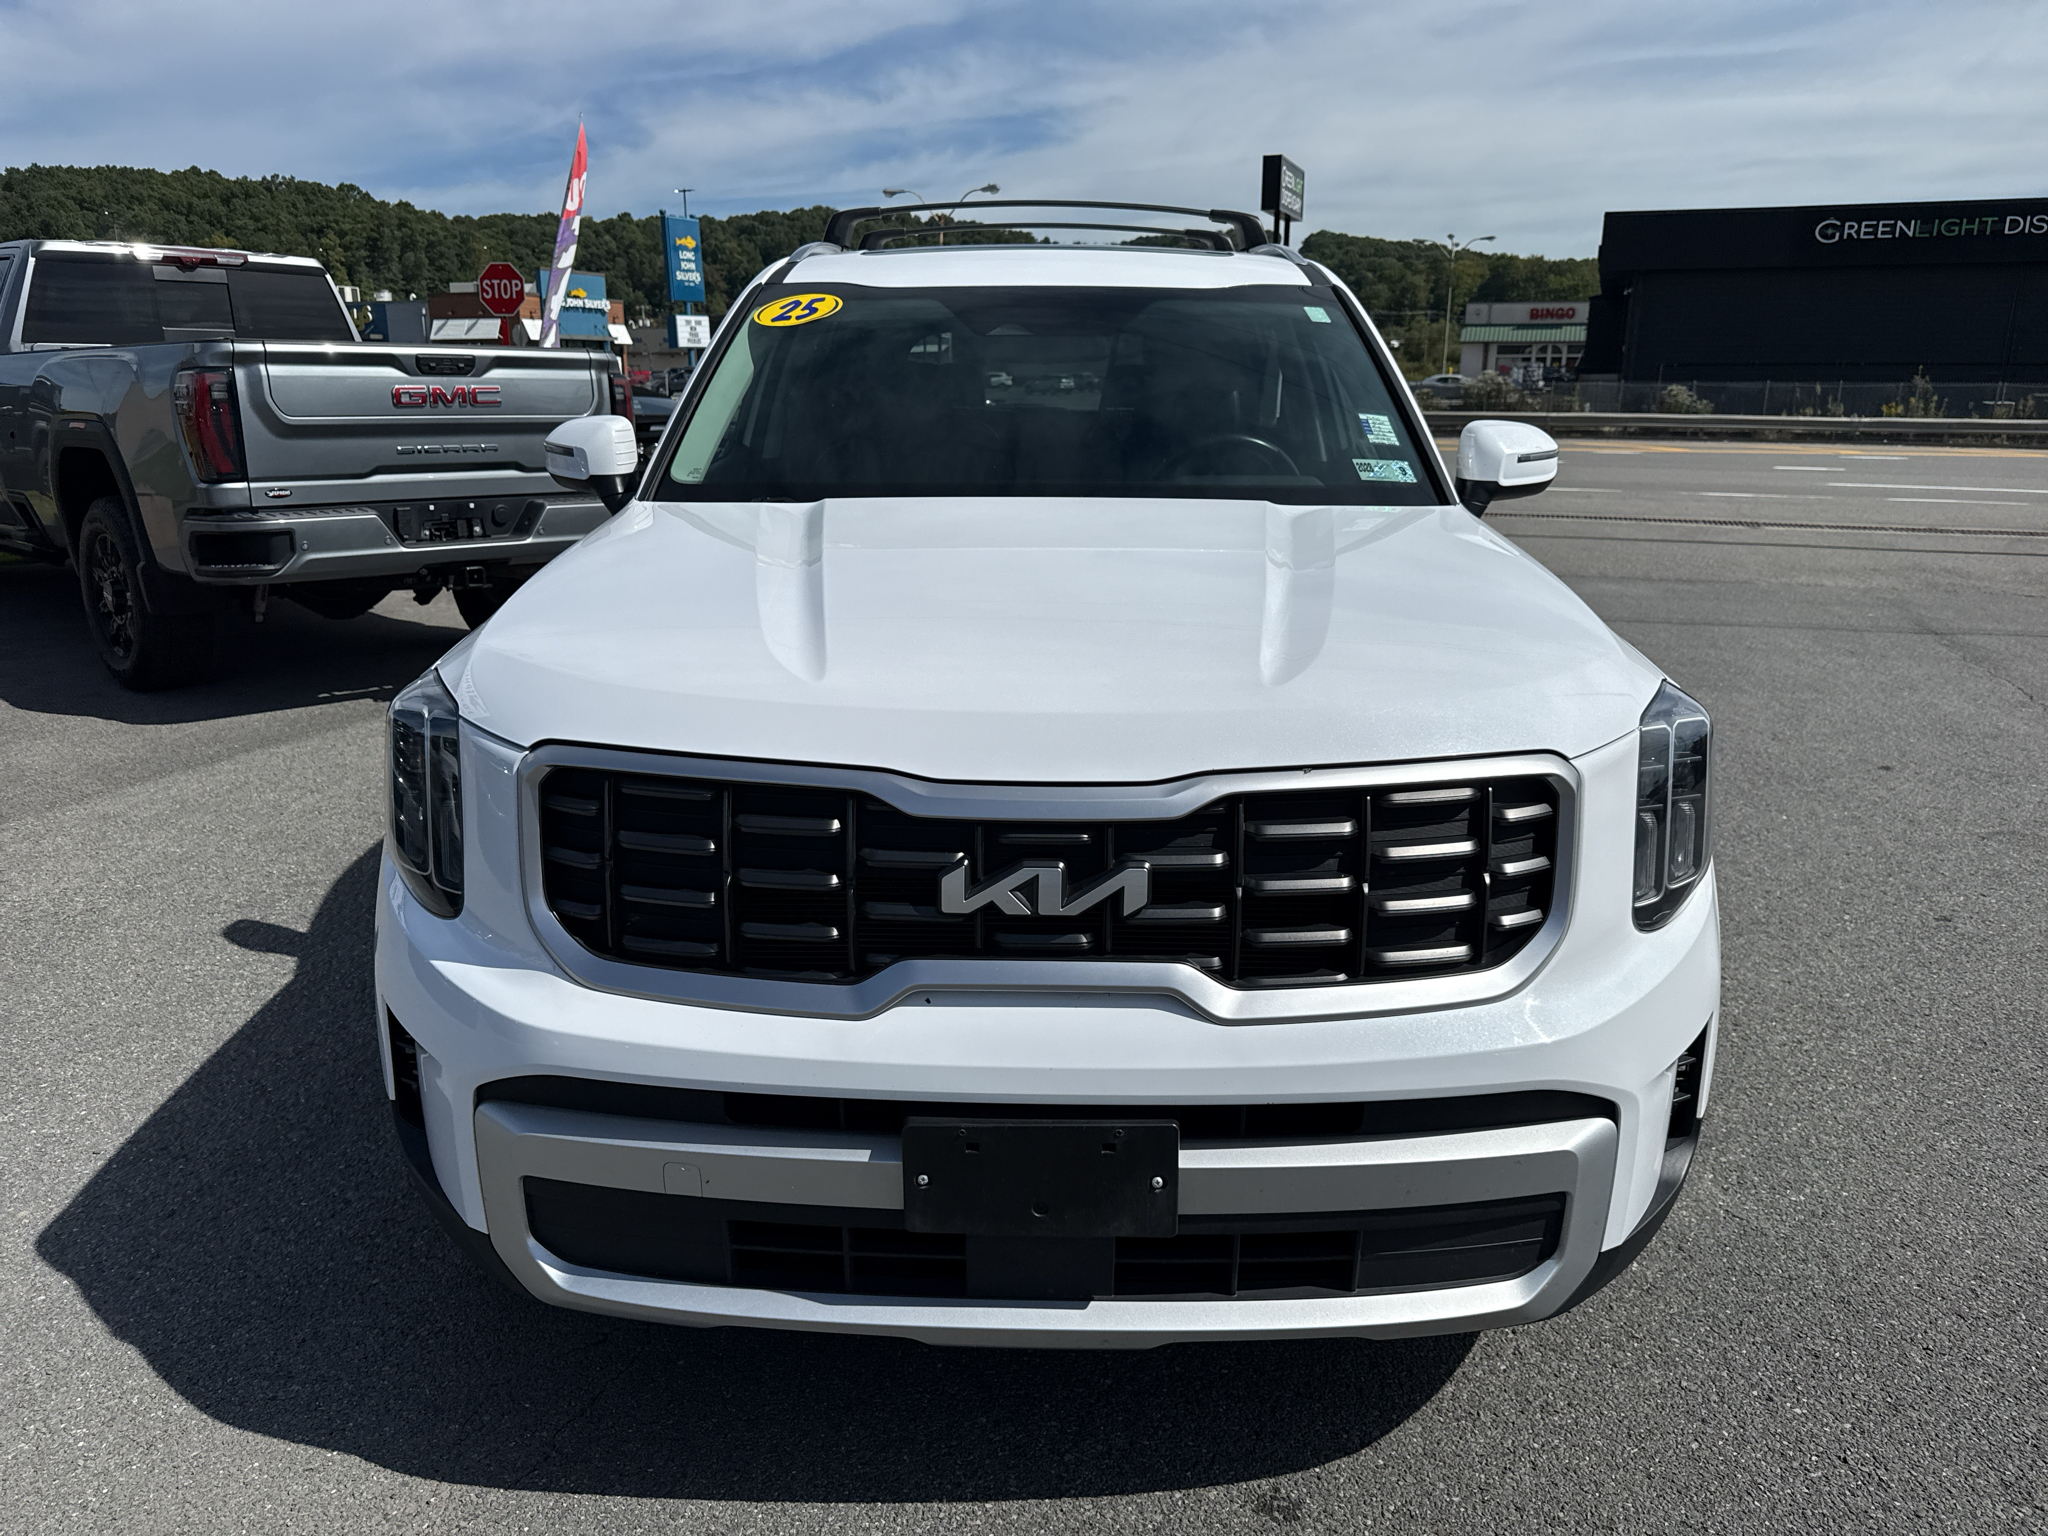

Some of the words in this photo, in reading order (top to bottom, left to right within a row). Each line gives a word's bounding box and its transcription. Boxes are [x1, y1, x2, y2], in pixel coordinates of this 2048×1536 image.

[1815, 217, 1999, 243] GREENLIGHT
[2004, 215, 2048, 235] DIS
[679, 250, 695, 260] LONG
[681, 261, 696, 270] JOHN
[482, 279, 521, 299] STOP
[565, 298, 584, 308] JOHN
[771, 297, 826, 322] 25
[1529, 307, 1576, 319] BINGO
[392, 385, 501, 408] GMC
[396, 443, 499, 455] SIERRA
[941, 858, 1150, 917] KIA
